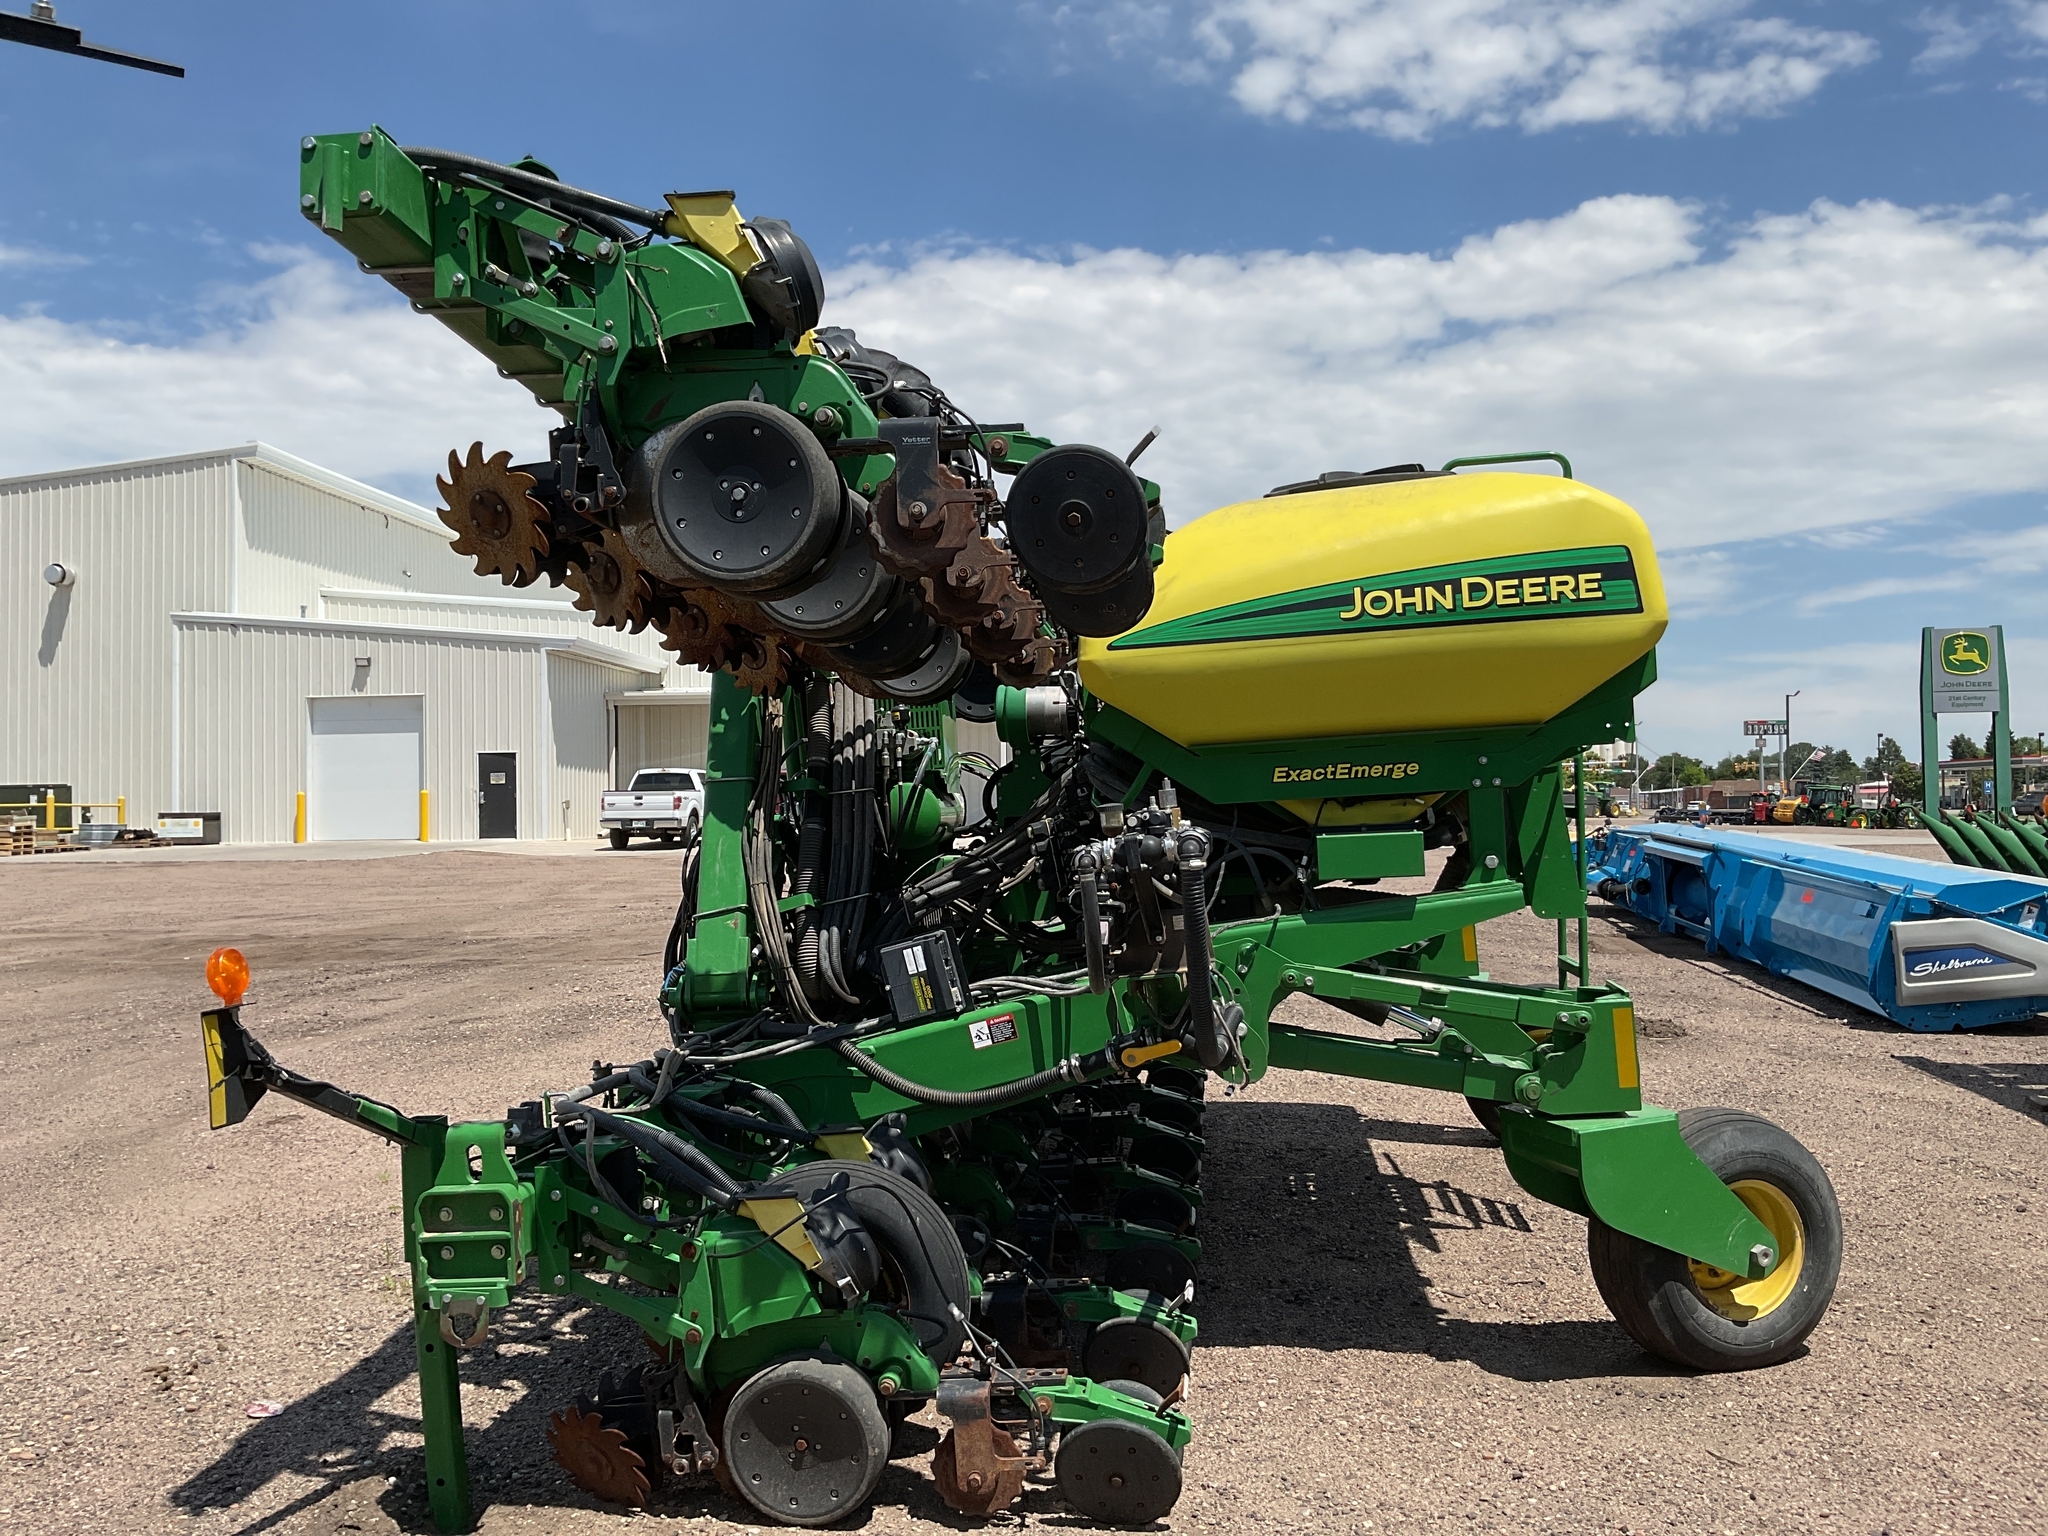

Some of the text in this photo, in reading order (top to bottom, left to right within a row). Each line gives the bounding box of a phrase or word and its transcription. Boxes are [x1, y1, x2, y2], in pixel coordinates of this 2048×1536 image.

[1339, 573, 1604, 620] JOHN DEERE
[1965, 680, 1993, 688] DEERE
[1272, 762, 1420, 783] ExactEmerge
[1909, 956, 1993, 977] Shelbourne
